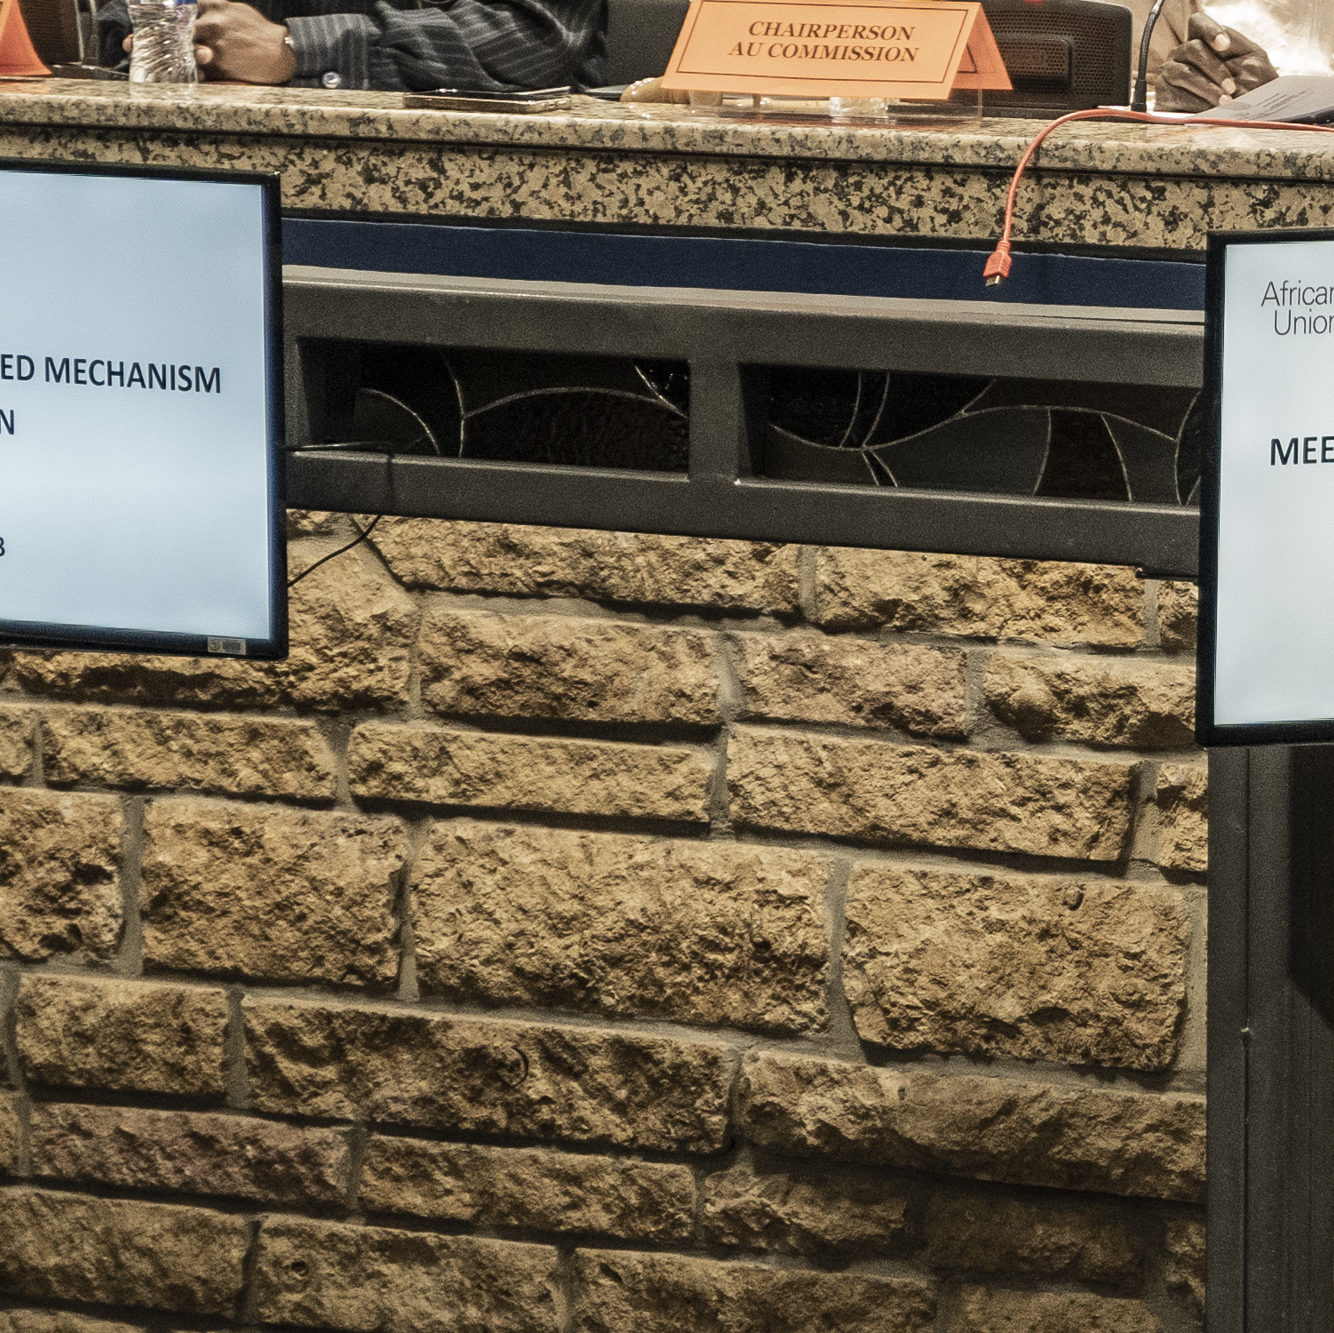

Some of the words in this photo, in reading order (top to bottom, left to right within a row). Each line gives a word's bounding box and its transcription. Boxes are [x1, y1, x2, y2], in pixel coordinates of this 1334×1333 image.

[748, 20, 916, 42] CHAIRPERSON
[727, 41, 763, 58] AU
[767, 42, 920, 63] COMMISSION
[44, 356, 221, 394] MECHANISM
